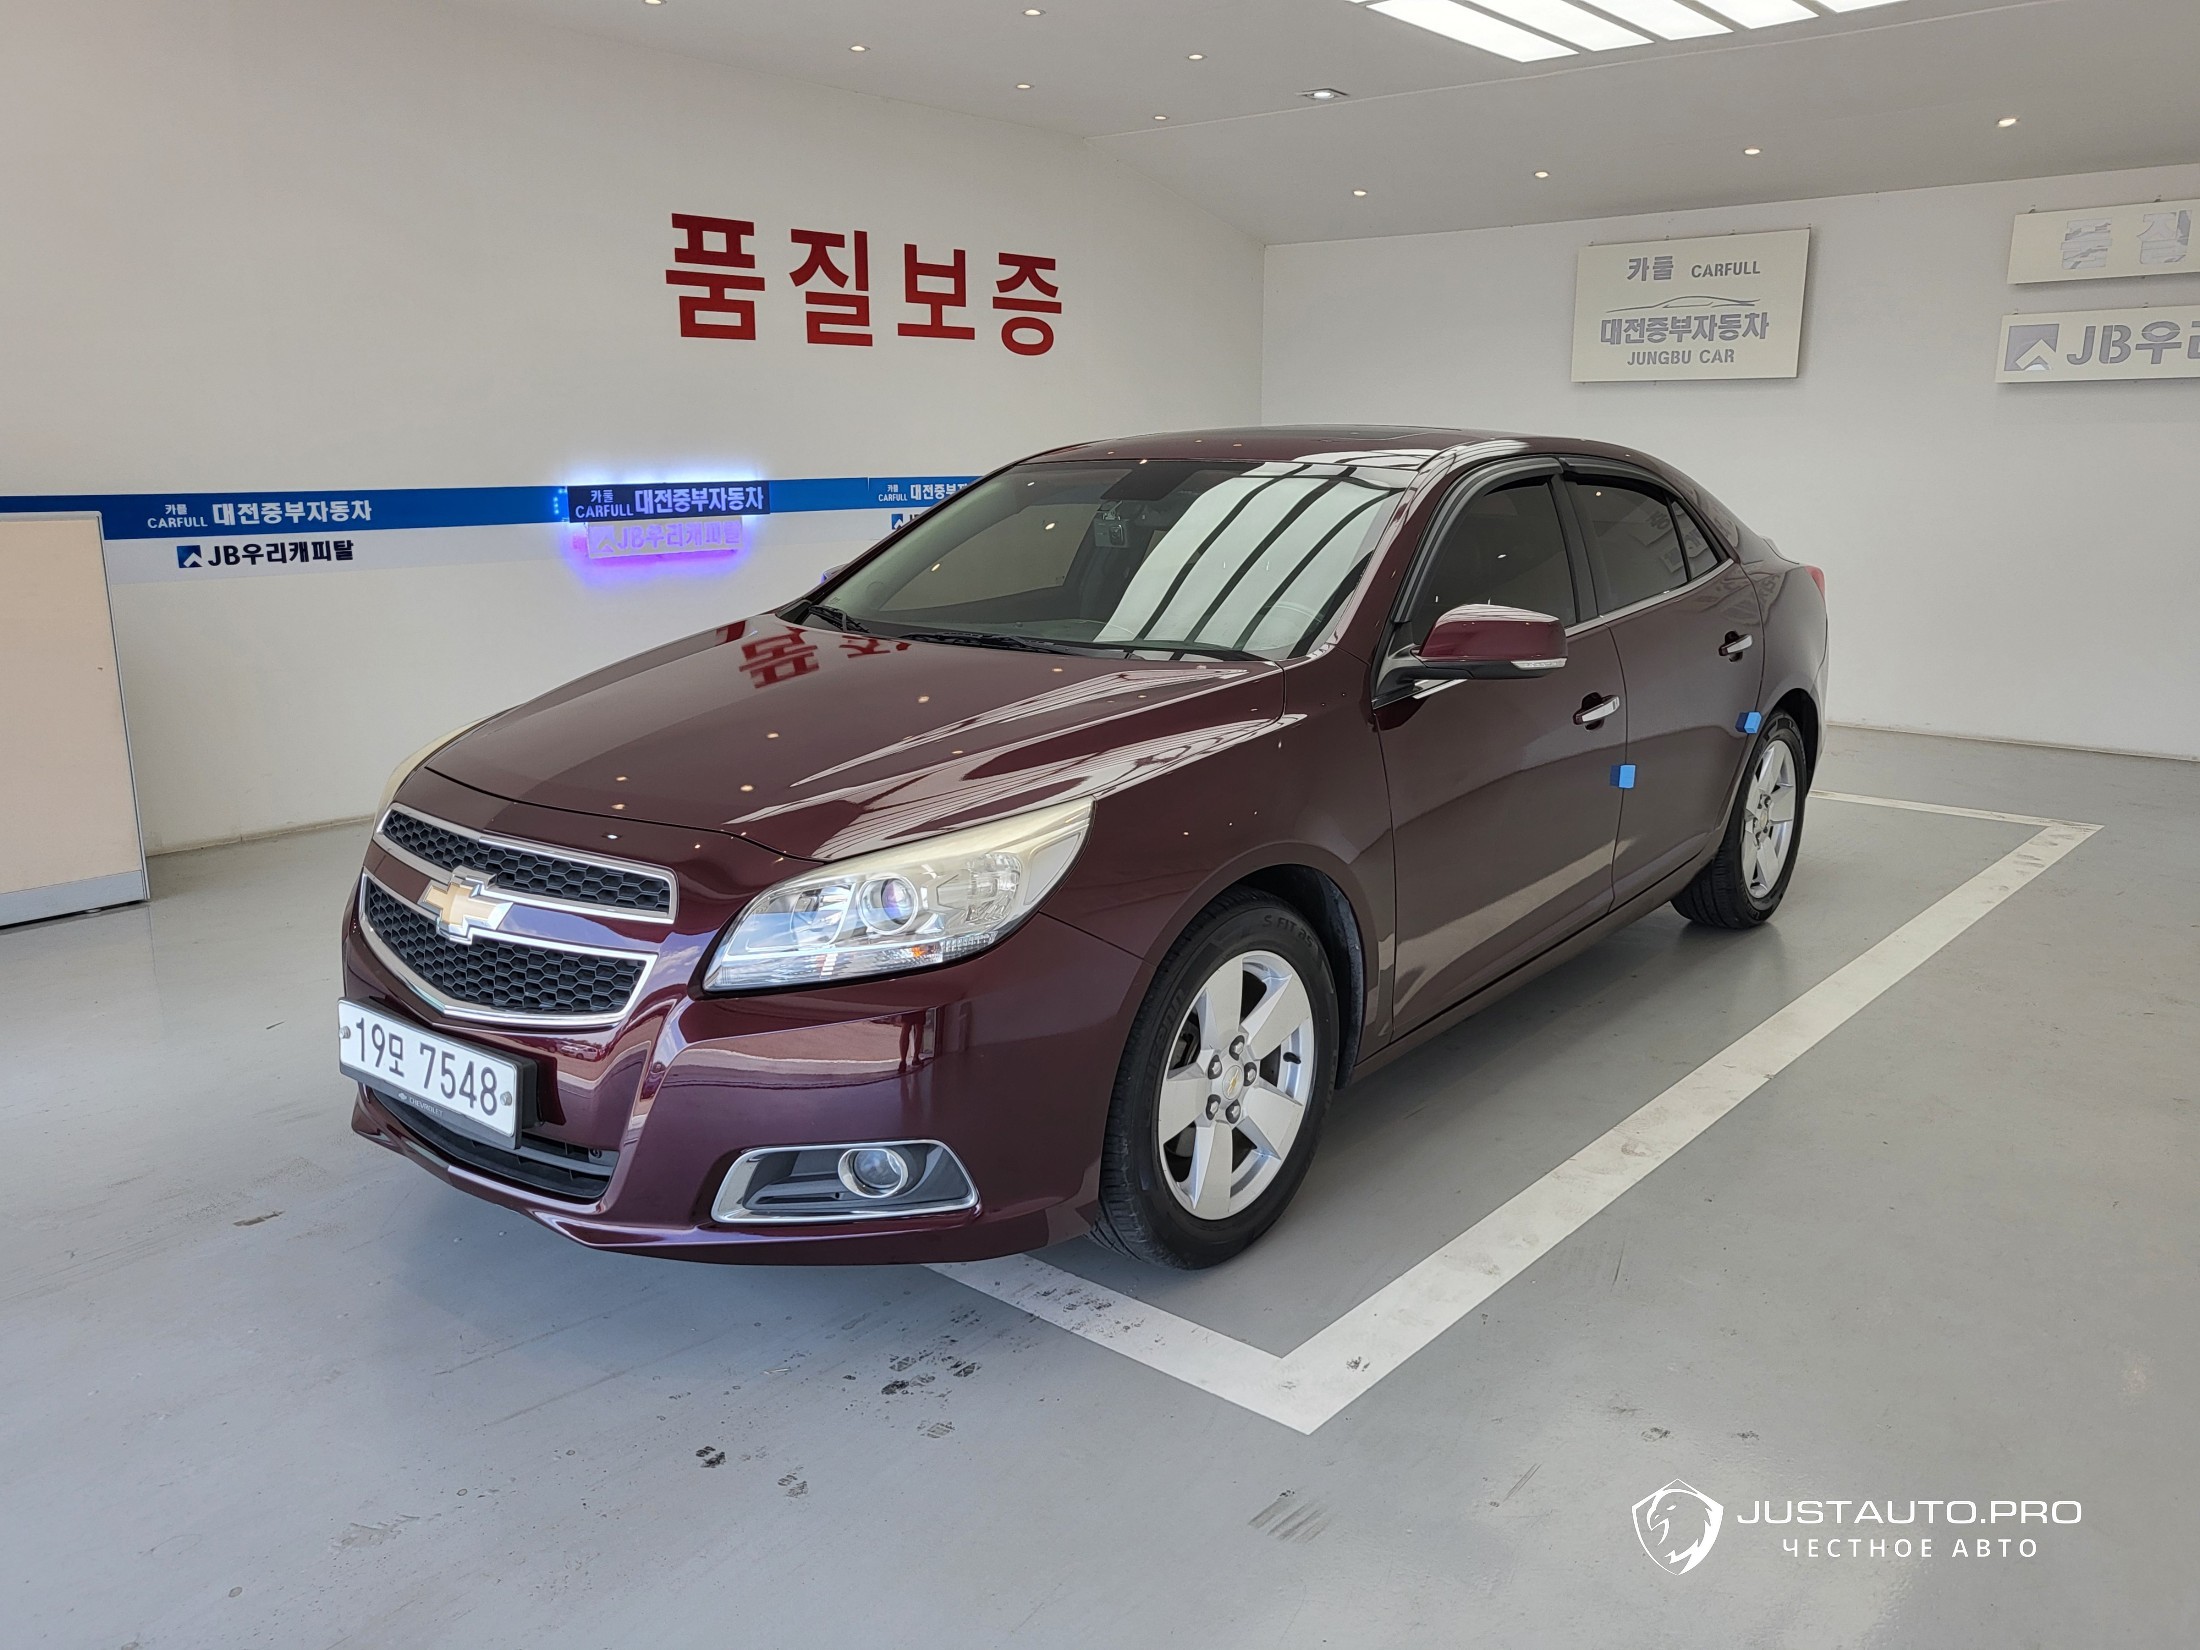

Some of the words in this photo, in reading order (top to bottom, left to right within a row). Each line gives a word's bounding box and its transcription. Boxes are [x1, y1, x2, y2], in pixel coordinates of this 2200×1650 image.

[1691, 261, 1760, 278] CARFULL
[665, 213, 1062, 356] 품질보증
[1600, 312, 1769, 345] 대전중부자동차
[1627, 350, 1691, 365] JUNGBU
[1699, 349, 1735, 364] CAR
[635, 487, 764, 514] 대전중부자동차
[878, 493, 908, 502] CARFULL
[147, 516, 208, 529] CARFULL
[212, 500, 372, 526] 대전중부자동차
[575, 504, 634, 519] CARFULL
[208, 540, 354, 566] JB우리캐피탈
[356, 1017, 405, 1078] 19모
[419, 1042, 498, 1116] 7548
[409, 1096, 444, 1117] CHEVROLET
